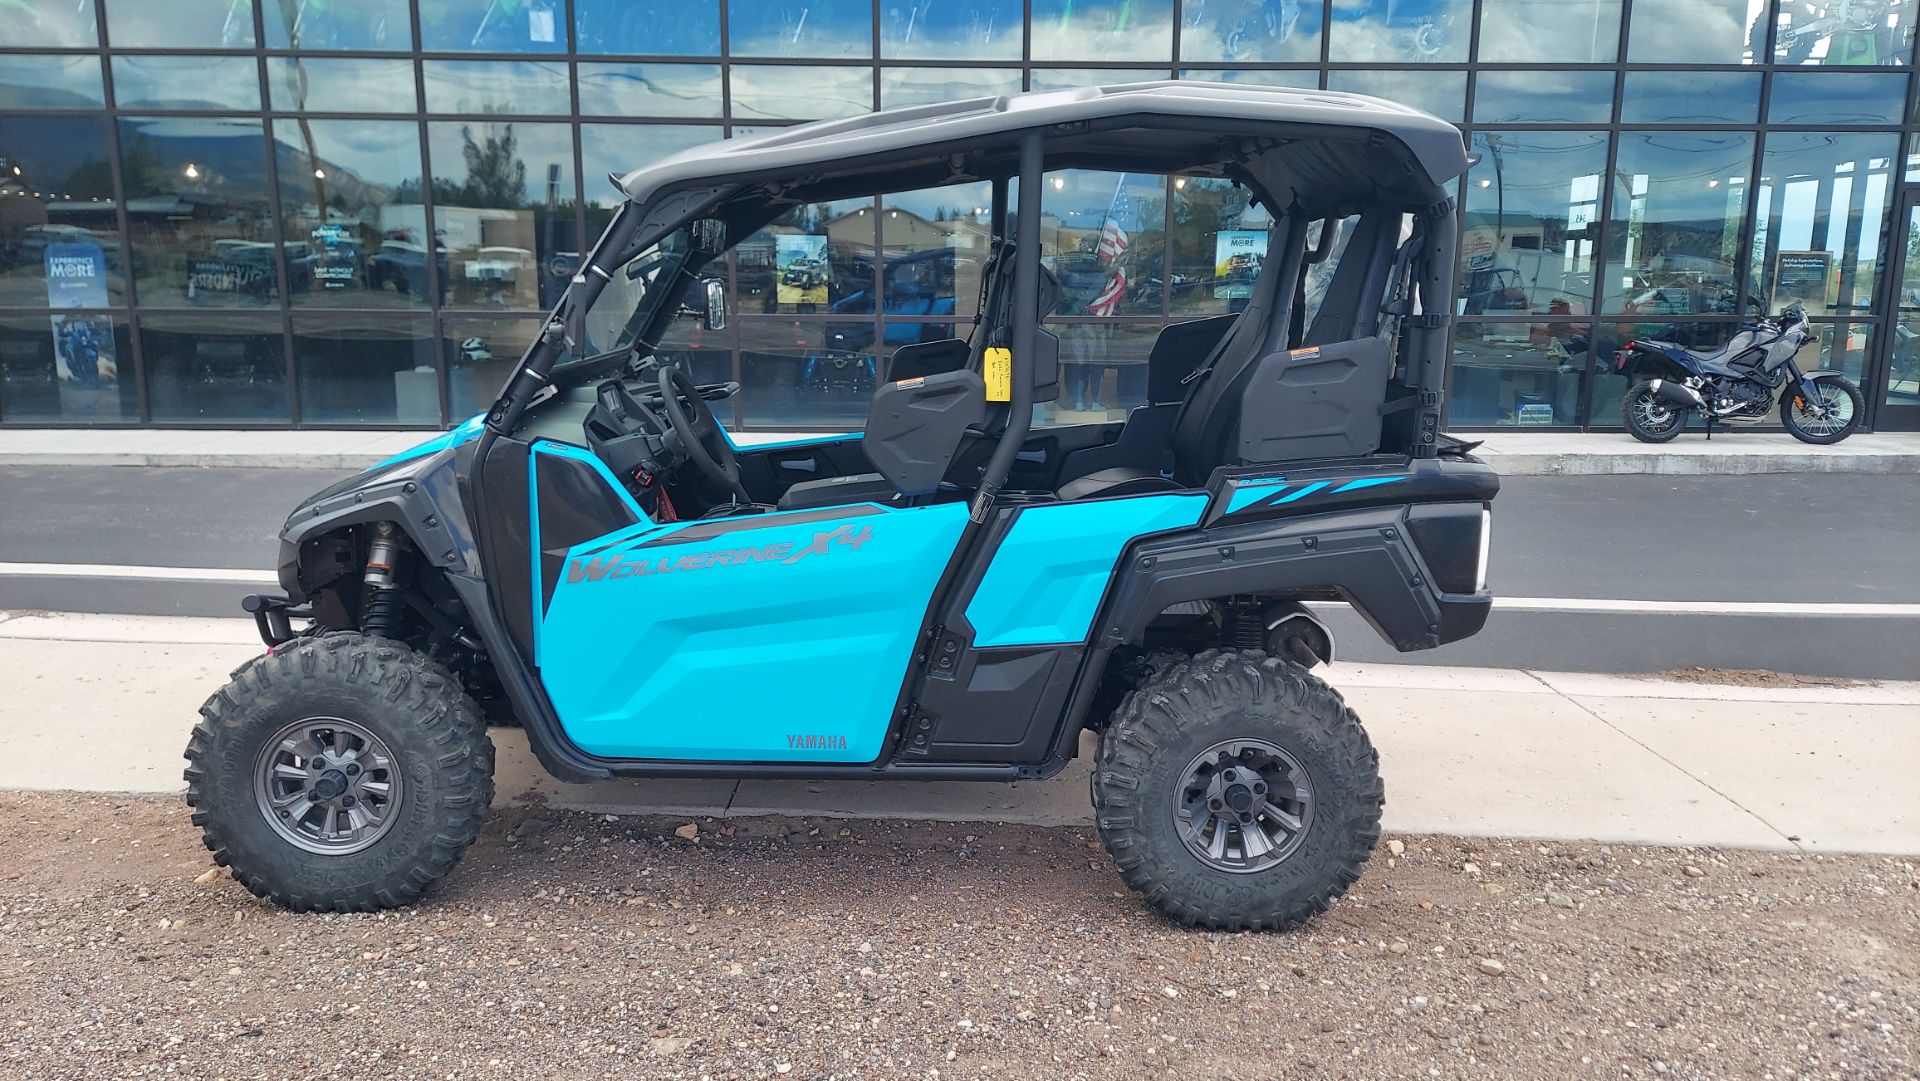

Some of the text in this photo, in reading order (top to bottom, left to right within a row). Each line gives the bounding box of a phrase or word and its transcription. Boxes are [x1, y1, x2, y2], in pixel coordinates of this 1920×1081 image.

[1230, 239, 1255, 247] MORE
[50, 263, 95, 277] MORE
[782, 524, 875, 565] X4
[786, 734, 848, 750] YAMAHA
